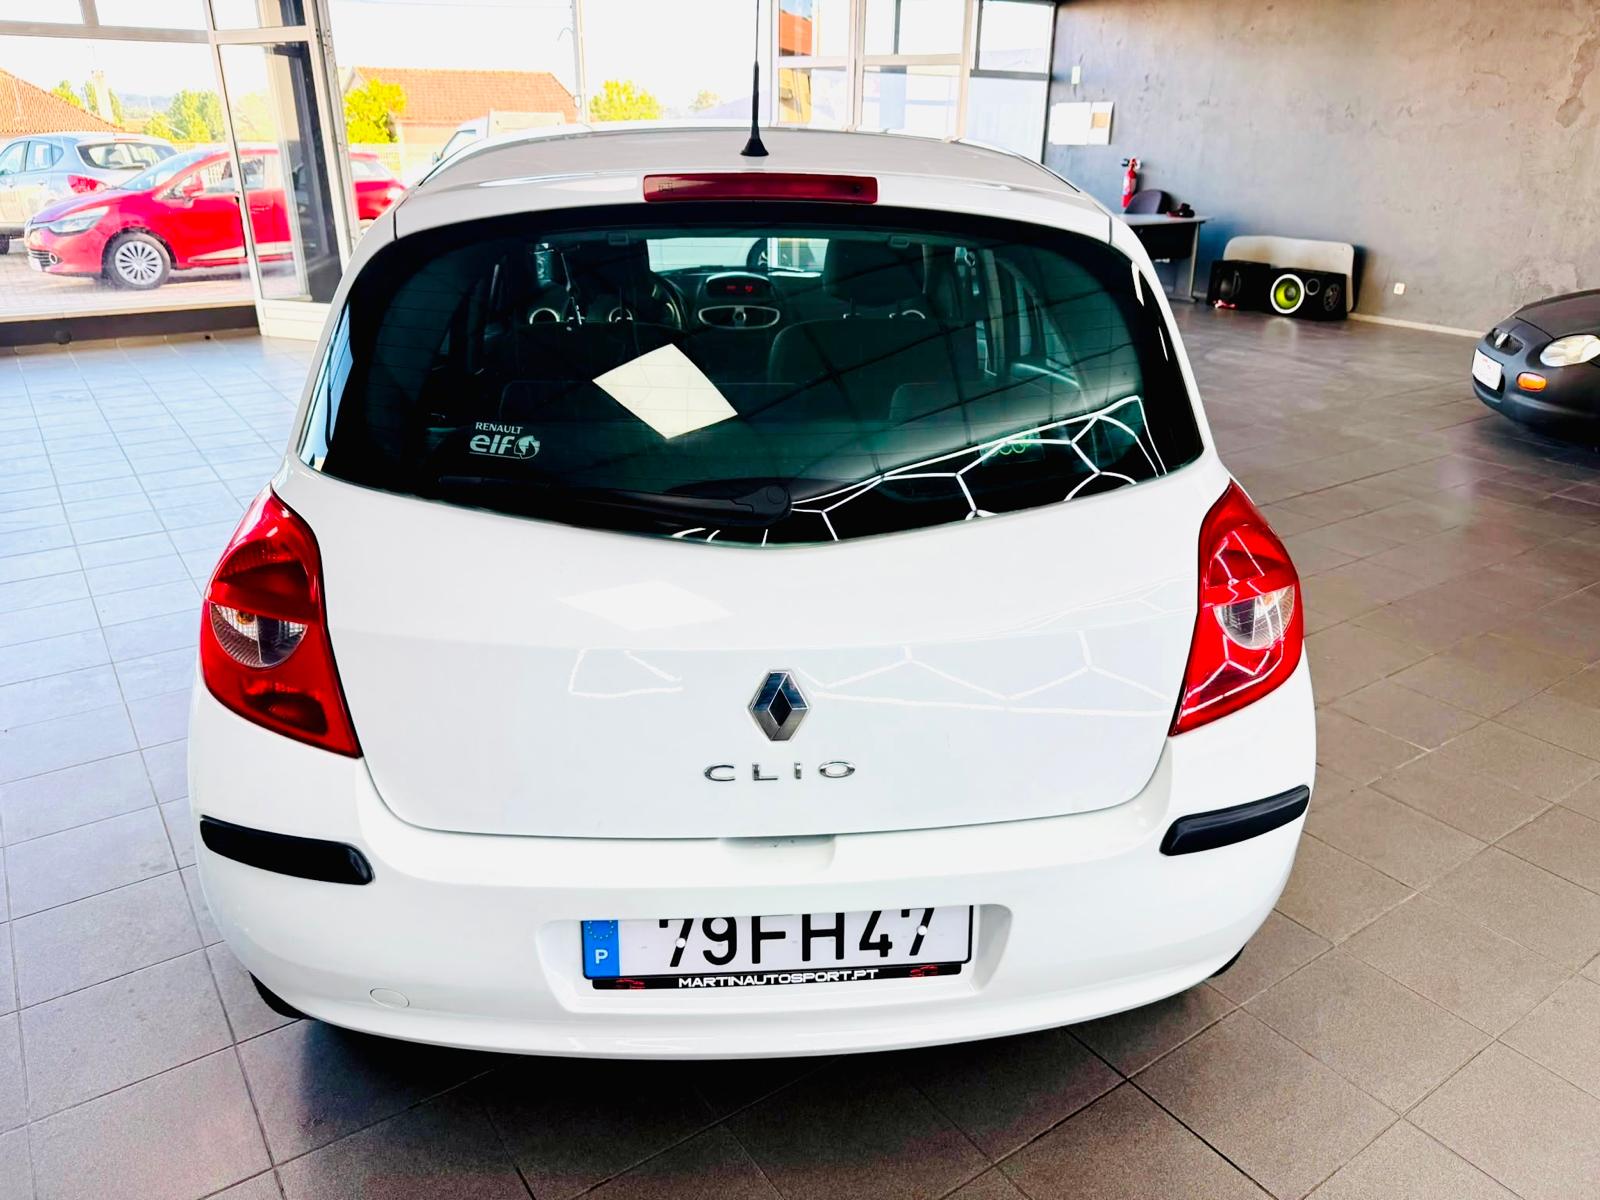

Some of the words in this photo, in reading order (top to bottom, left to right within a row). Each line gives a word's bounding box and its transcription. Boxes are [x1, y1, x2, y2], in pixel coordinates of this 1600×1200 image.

[475, 421, 524, 434] RENAULT
[469, 434, 515, 454] elf
[704, 760, 856, 782] CLIO
[594, 949, 609, 964] P
[678, 968, 879, 988] MARTINAUTOSPORT.PT
